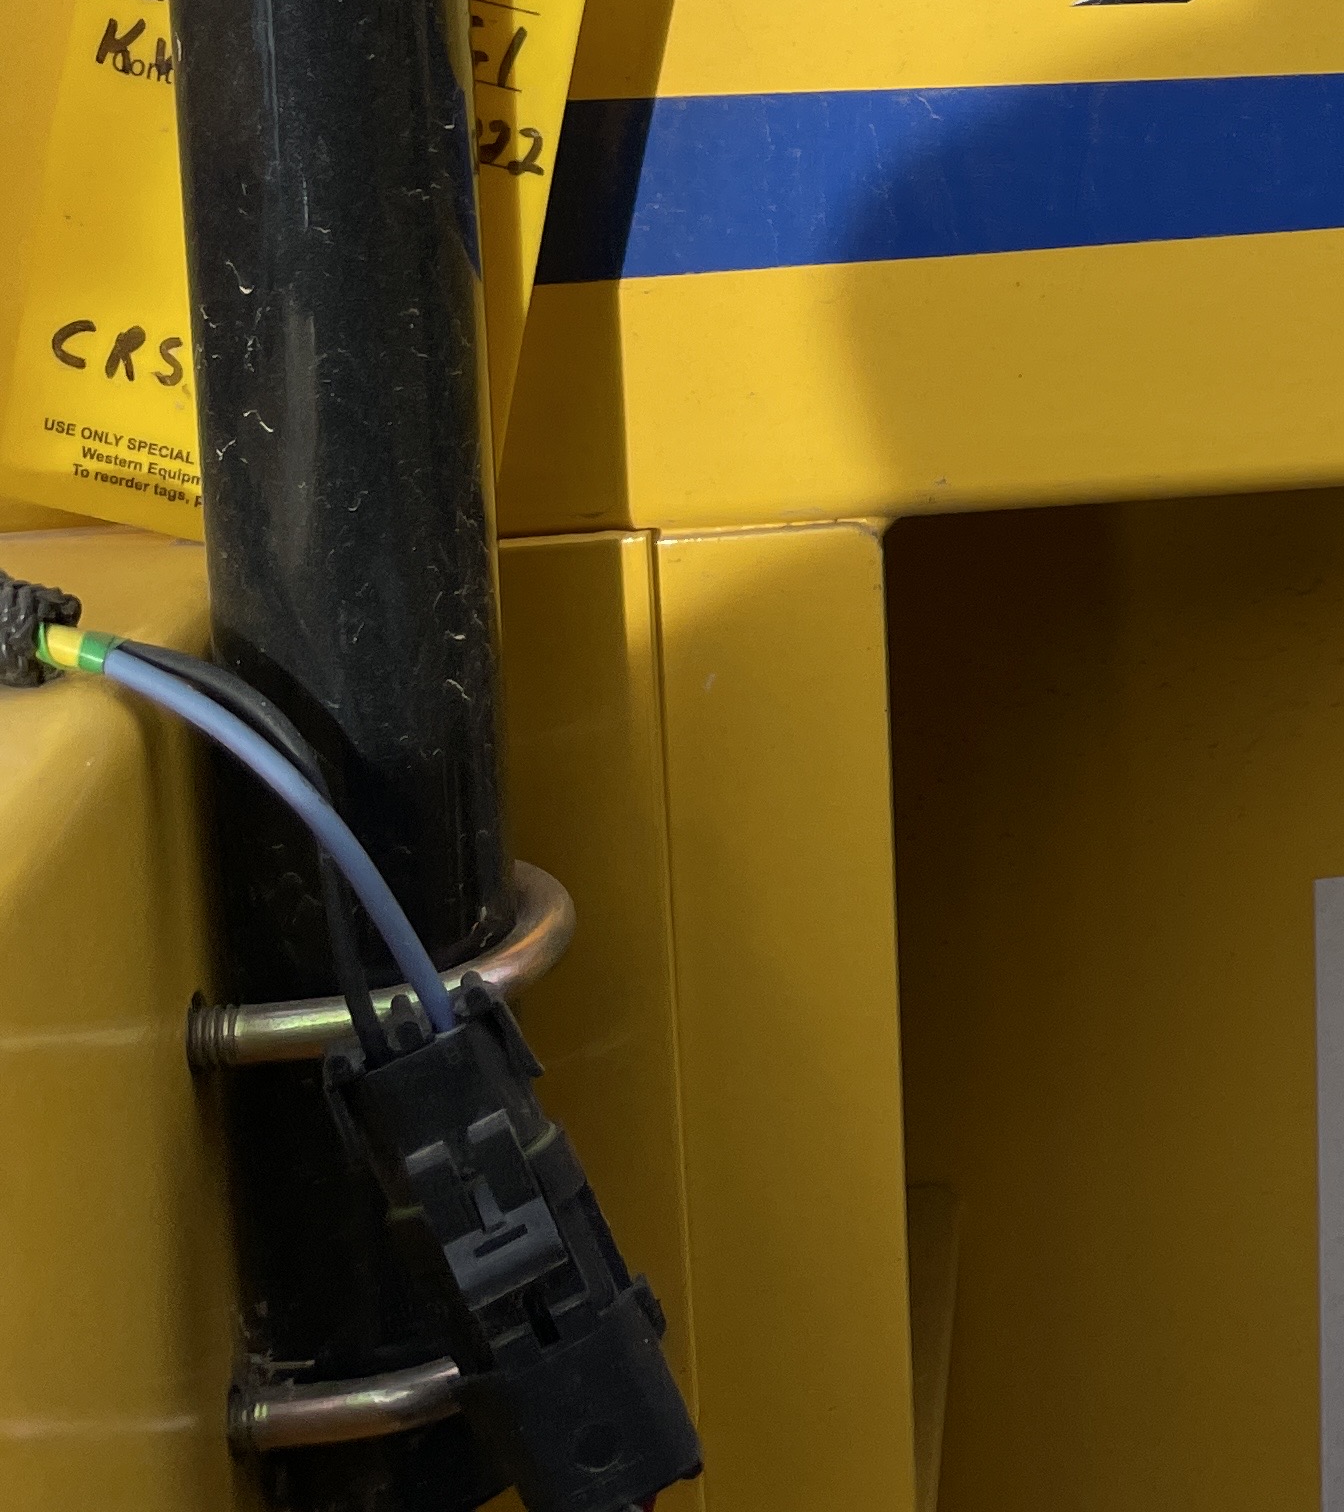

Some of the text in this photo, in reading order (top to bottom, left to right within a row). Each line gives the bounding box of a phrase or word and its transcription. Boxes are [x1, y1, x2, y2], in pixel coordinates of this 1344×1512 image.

[44, 417, 194, 465] USE ONLY SPECIAL
[82, 445, 142, 470] Western
[73, 463, 90, 478] To
[94, 470, 150, 492] reorder
[154, 482, 190, 505] tags,
